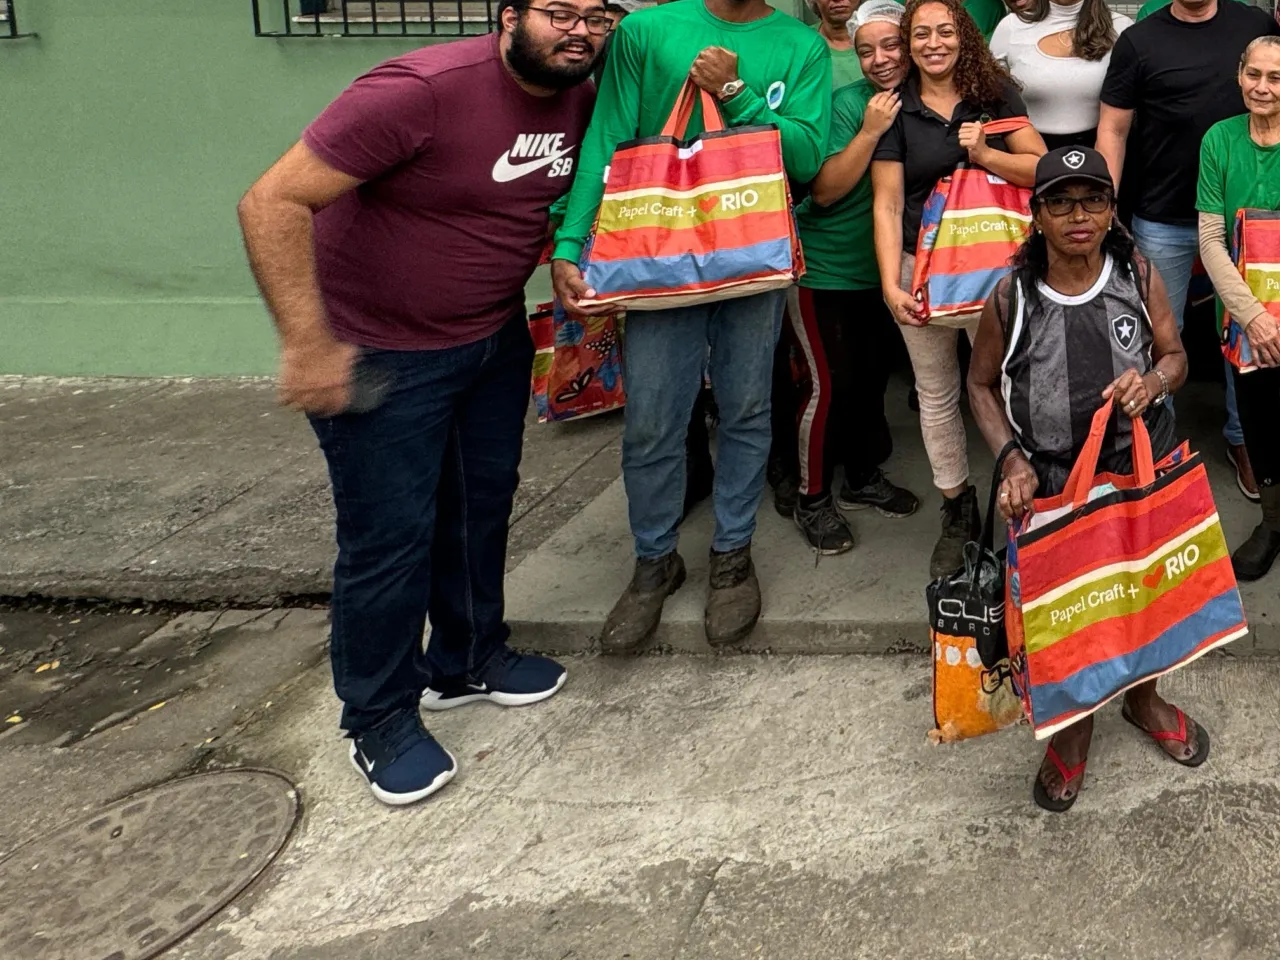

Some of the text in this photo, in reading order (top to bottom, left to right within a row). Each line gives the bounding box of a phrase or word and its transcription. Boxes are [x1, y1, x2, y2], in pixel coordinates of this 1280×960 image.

[510, 132, 566, 158] NIKE
[547, 157, 574, 178] SB
[618, 204, 648, 219] Papel
[650, 202, 684, 217] Craft
[720, 189, 759, 212] RIO
[949, 221, 979, 238] Papel
[980, 220, 1009, 232] Craft
[1050, 595, 1086, 626] Papel
[1087, 583, 1126, 608] Craft
[1165, 543, 1200, 581] RIO
